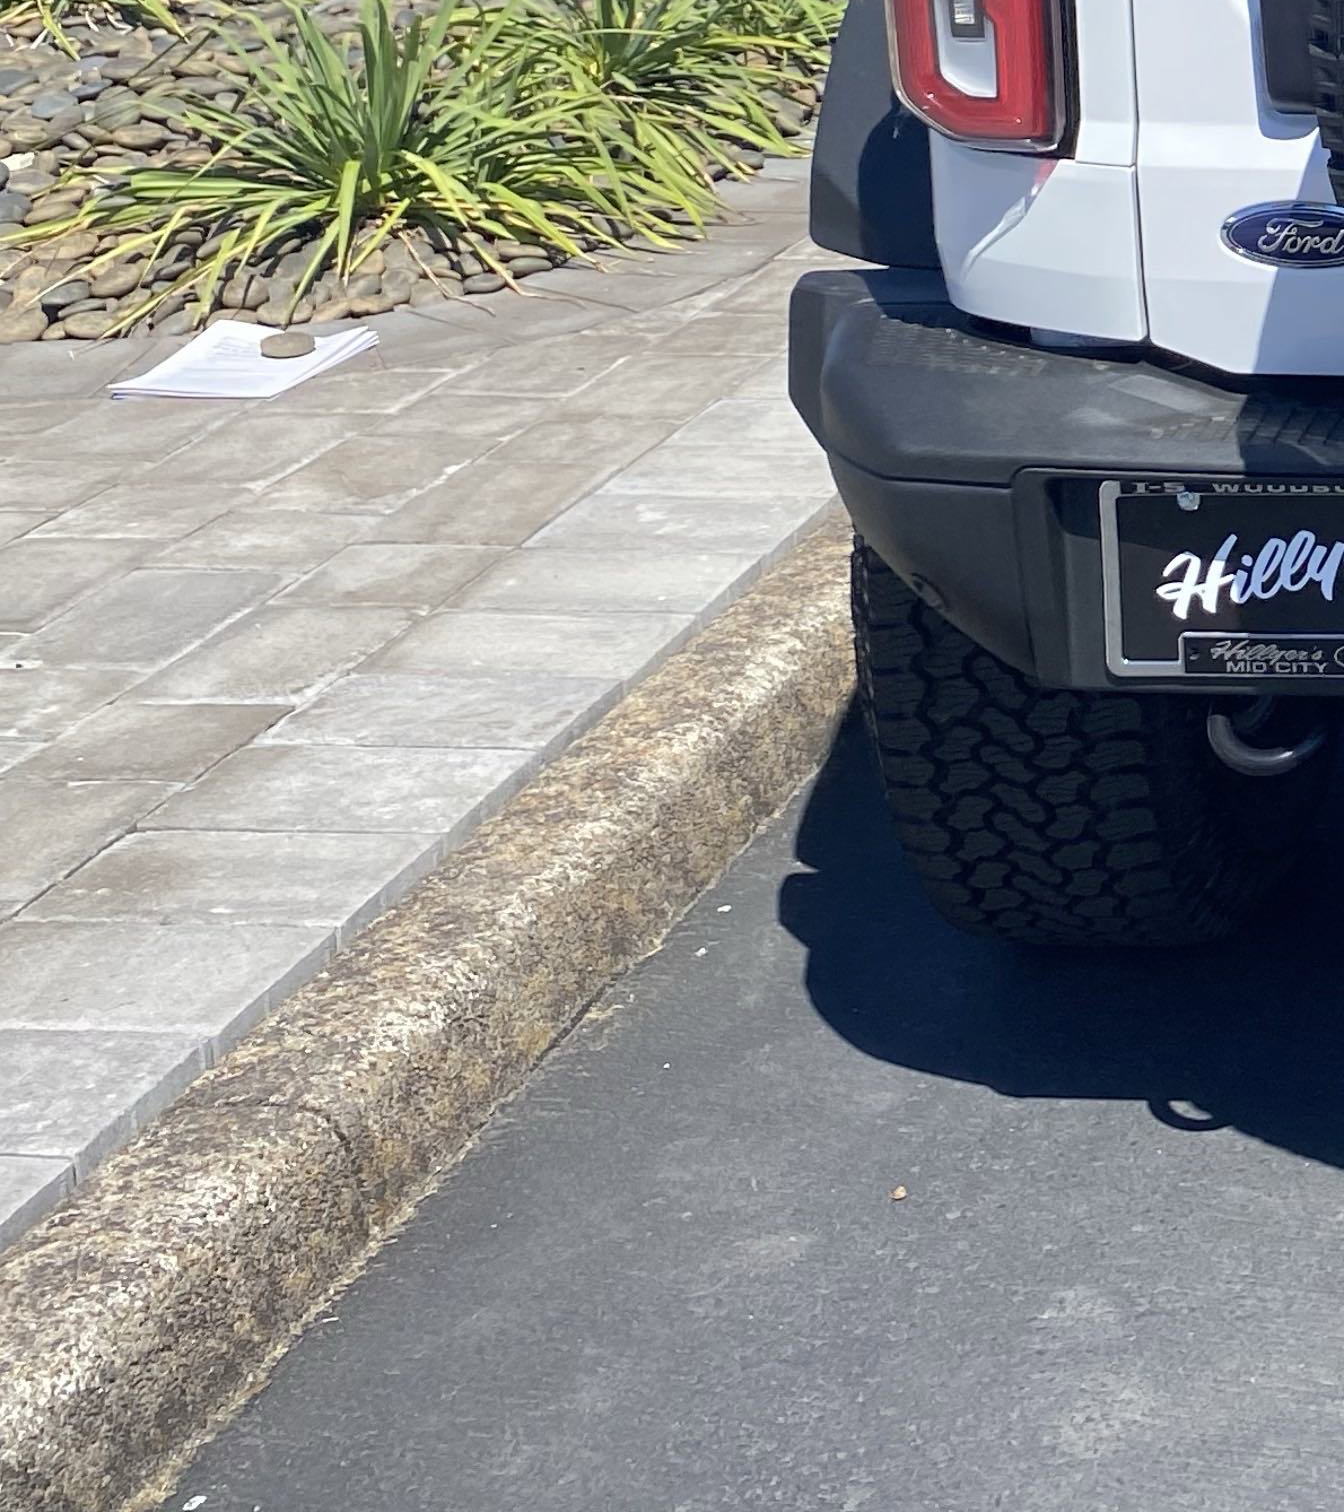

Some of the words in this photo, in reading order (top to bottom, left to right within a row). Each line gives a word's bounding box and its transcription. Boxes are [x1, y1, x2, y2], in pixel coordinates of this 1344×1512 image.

[1209, 640, 1323, 663] Hillyer's
[1225, 661, 1267, 673] MID
[1275, 662, 1328, 673] CITY
